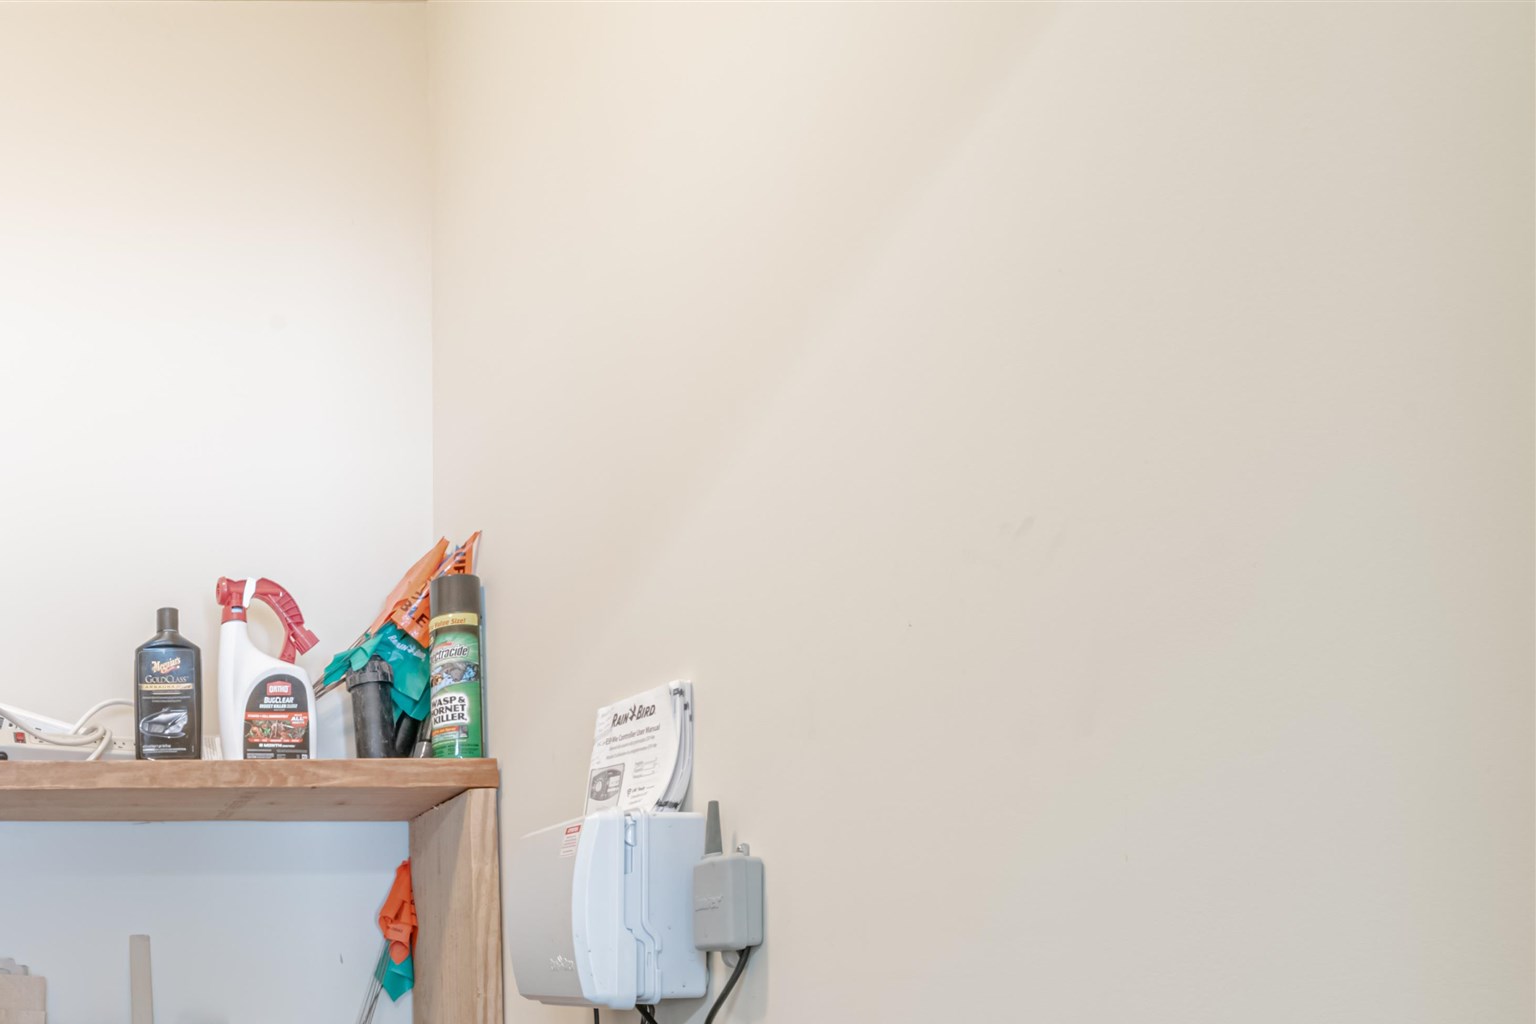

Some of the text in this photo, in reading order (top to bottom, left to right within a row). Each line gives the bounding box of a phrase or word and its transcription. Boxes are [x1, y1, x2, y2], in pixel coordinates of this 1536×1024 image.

[458, 696, 466, 704] &
[432, 704, 466, 716] ORNET
[611, 704, 656, 728] RAIN BIRD
